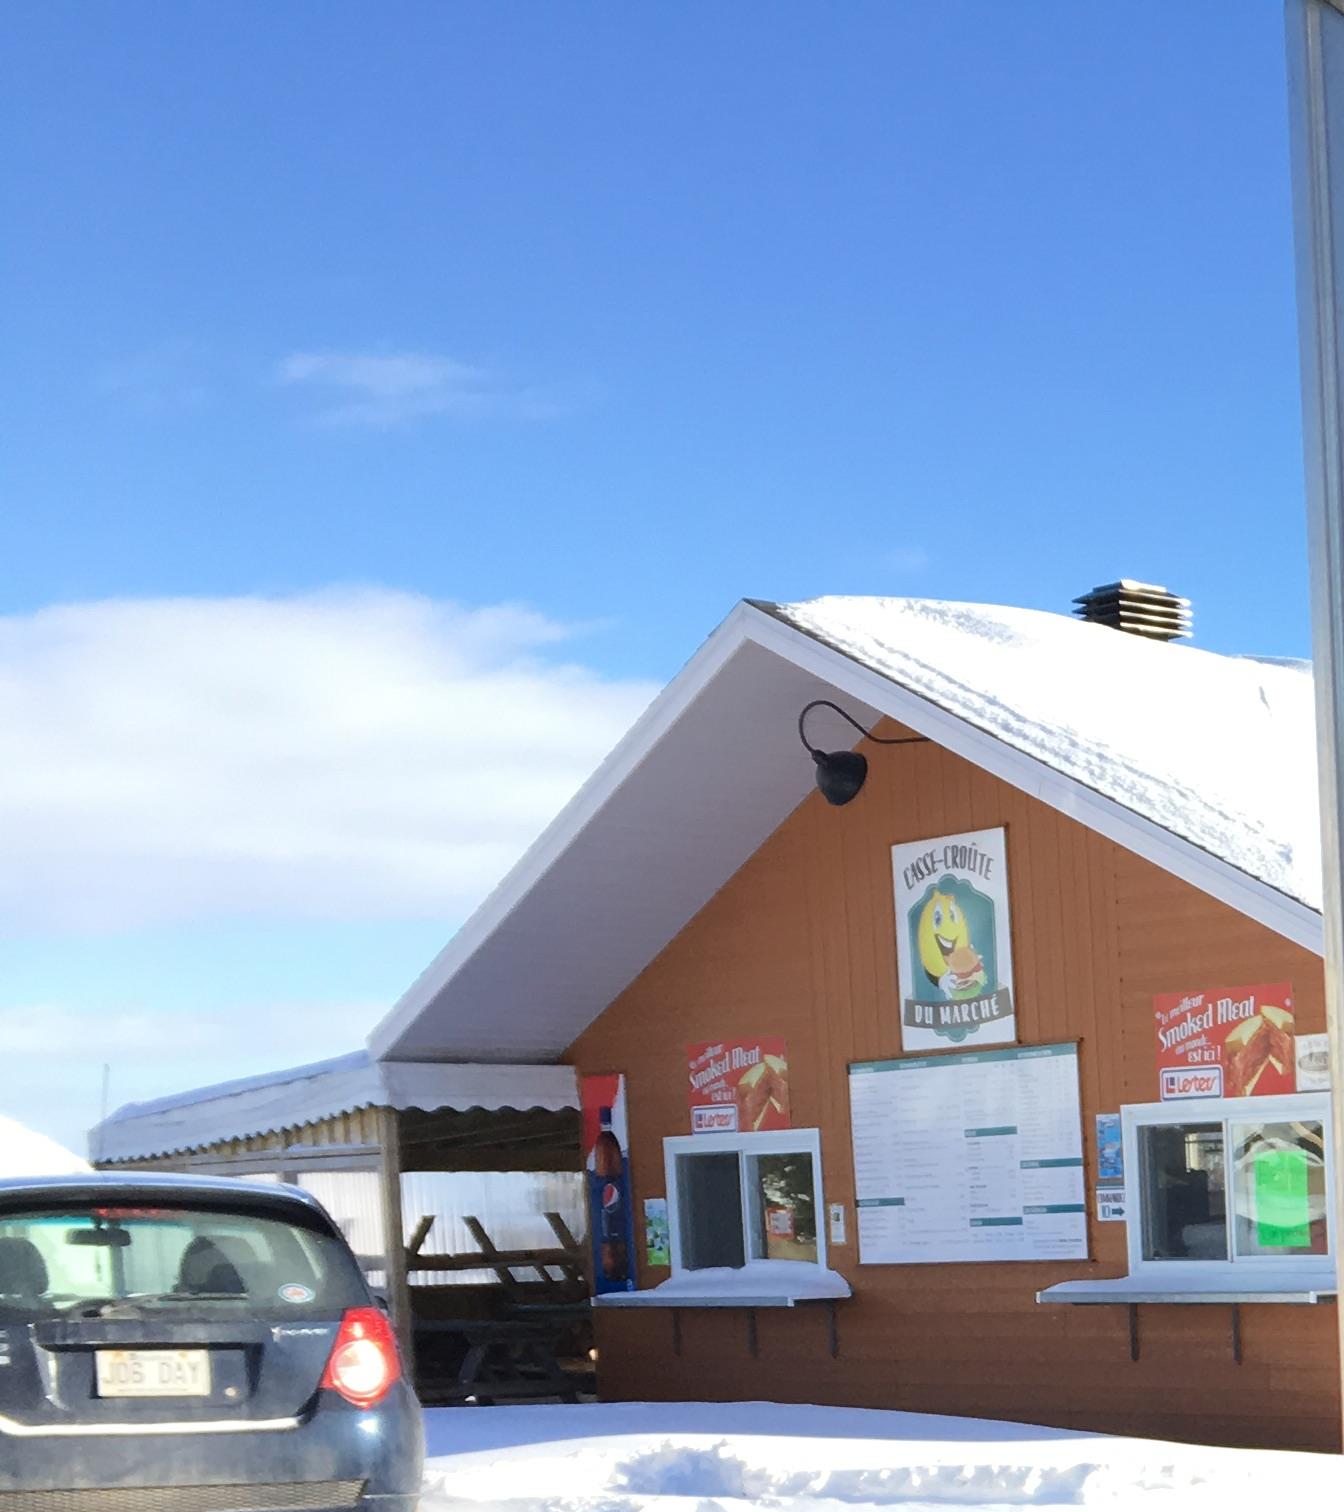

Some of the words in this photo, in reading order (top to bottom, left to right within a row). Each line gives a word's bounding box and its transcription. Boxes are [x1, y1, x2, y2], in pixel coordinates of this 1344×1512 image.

[903, 842, 995, 890] CASSE-CROÛTE
[914, 1004, 933, 1025] DU
[939, 993, 1000, 1025] MARCHÉ
[1158, 1004, 1213, 1053] Smoked
[1217, 996, 1255, 1025] Meat
